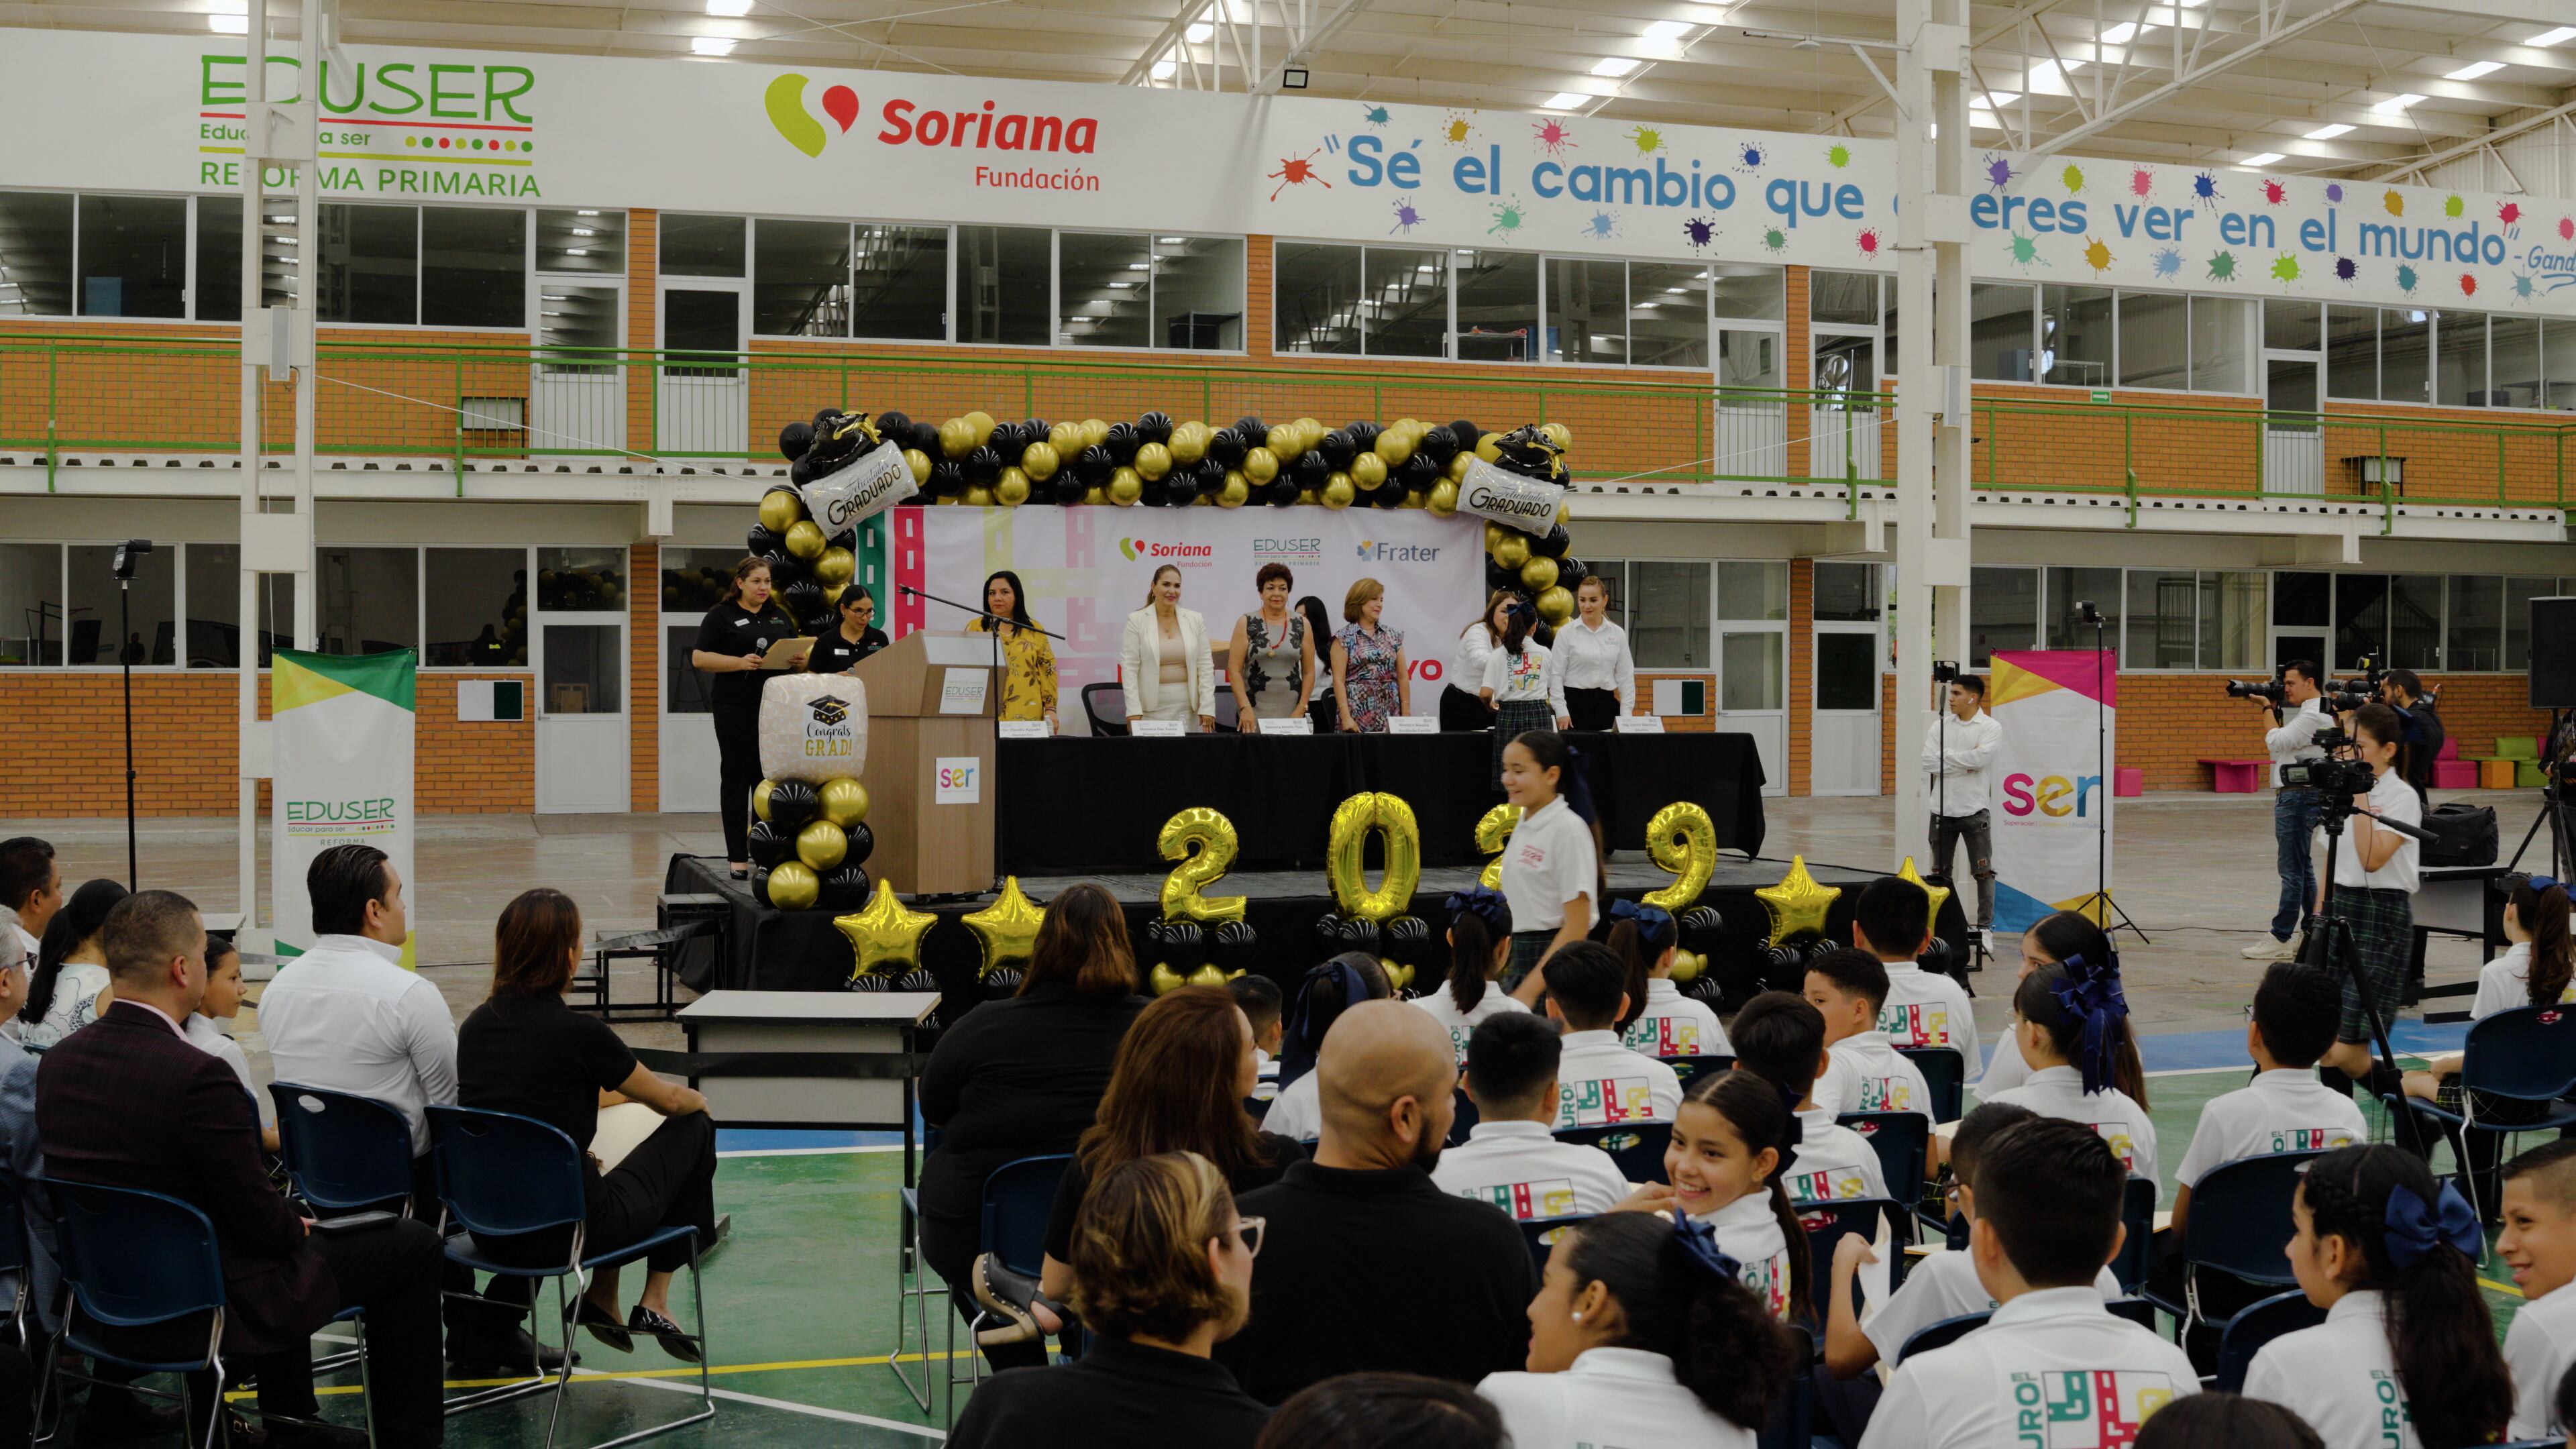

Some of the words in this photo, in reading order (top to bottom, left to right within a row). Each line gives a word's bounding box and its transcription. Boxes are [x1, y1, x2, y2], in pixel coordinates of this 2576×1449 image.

[877, 98, 1098, 154] Soriana
[341, 133, 370, 146] ser
[378, 168, 541, 198] PRIMARIA
[975, 166, 1099, 191] Fundación
[1453, 145, 1501, 195] el
[1532, 158, 1736, 211] cambio
[1766, 178, 1864, 228] que
[2114, 204, 2194, 241] ver
[2220, 212, 2275, 248] en
[2300, 209, 2335, 253] el
[1150, 542, 1212, 557] Soriana
[1253, 538, 1321, 551] EDUSER
[1377, 542, 1440, 561] Frater
[945, 686, 984, 696] EDUSER
[807, 722, 851, 743] Congrats
[806, 739, 853, 756] GRAD!
[941, 768, 975, 788] ser
[2002, 773, 2102, 817] ser
[287, 798, 394, 821] EDUSER
[320, 838, 366, 846] REFORMA
[2010, 1372, 2037, 1382] EL
